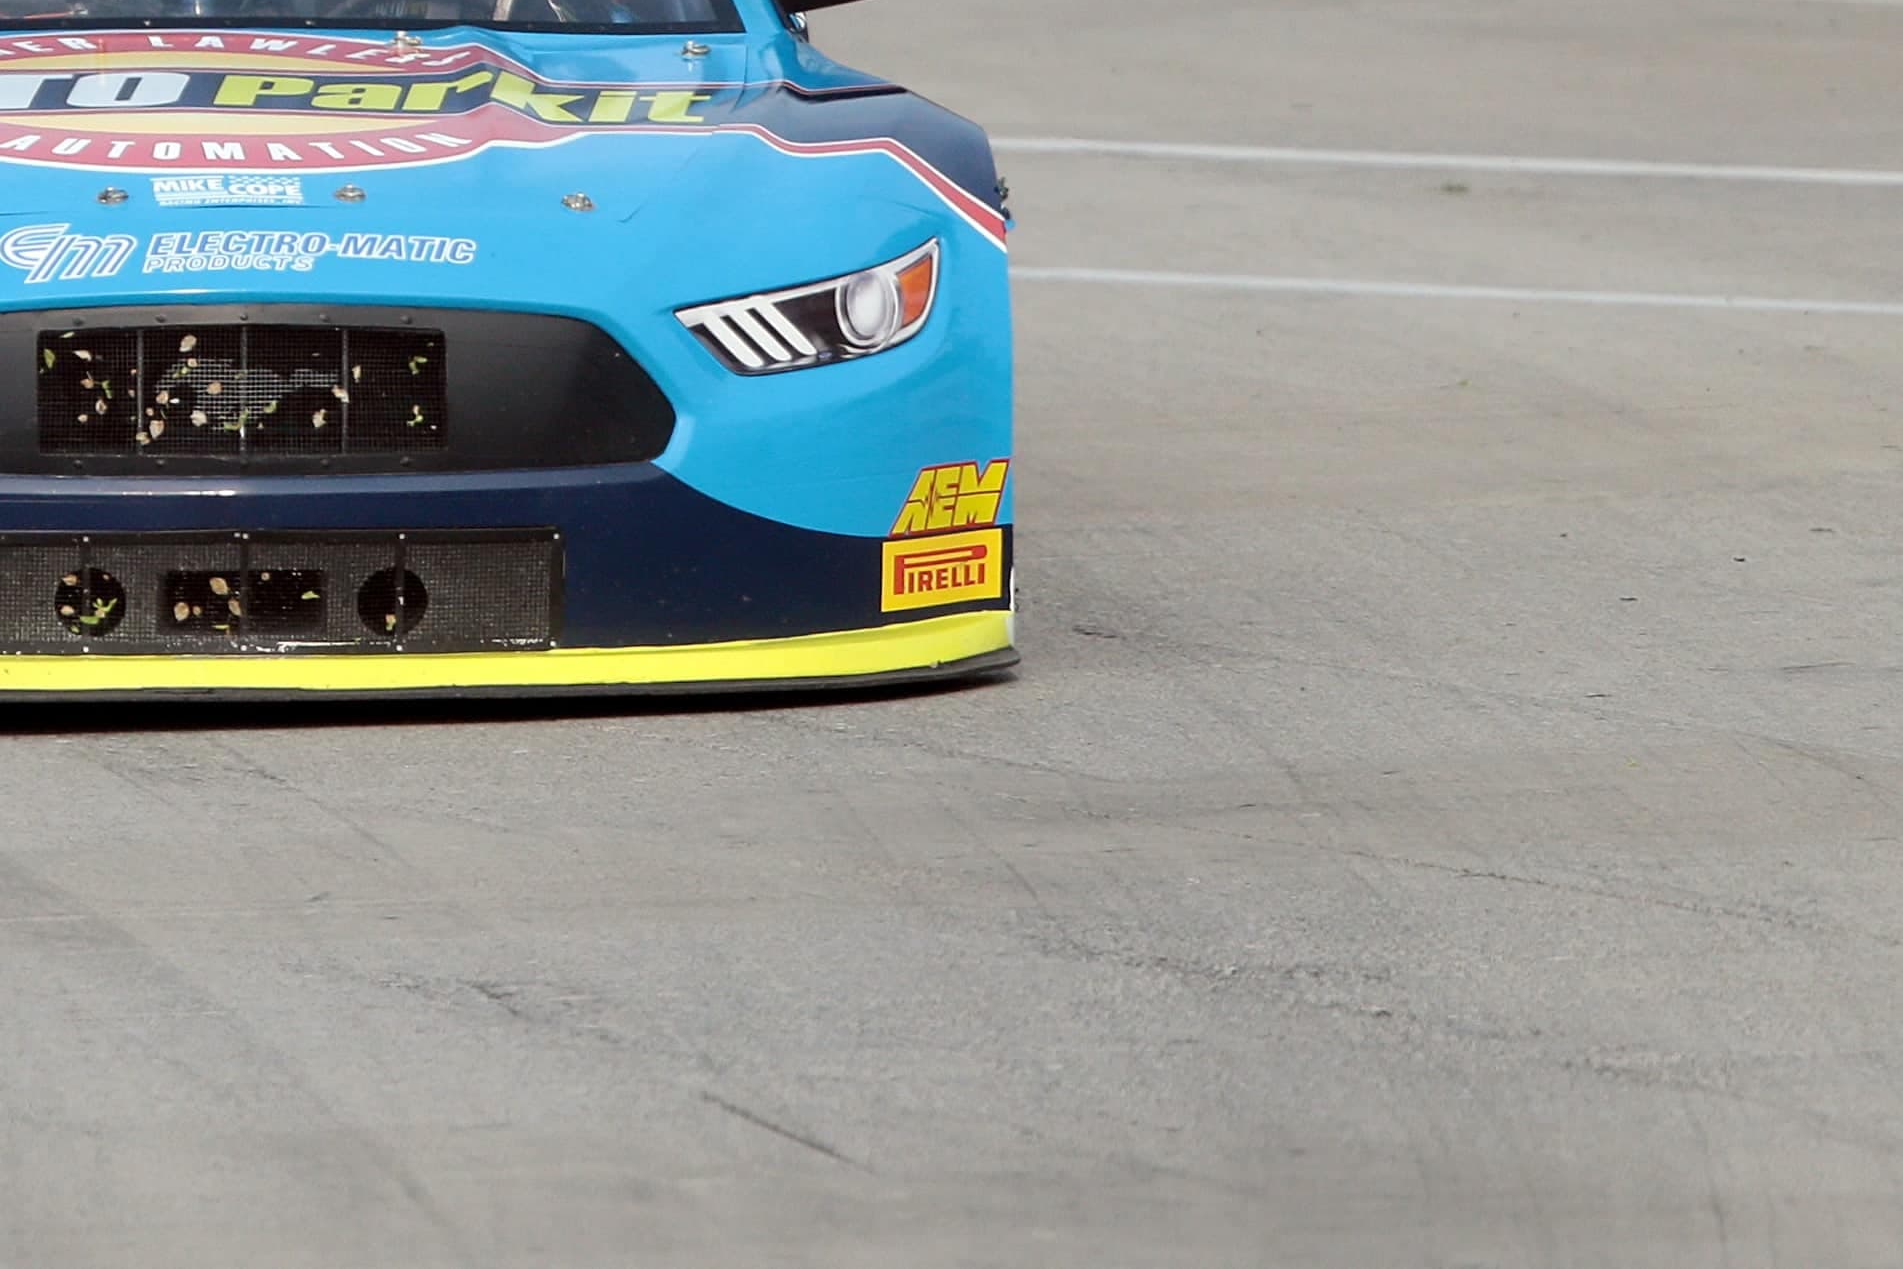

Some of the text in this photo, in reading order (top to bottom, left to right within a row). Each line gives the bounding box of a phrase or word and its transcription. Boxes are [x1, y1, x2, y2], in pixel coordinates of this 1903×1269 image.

[153, 177, 303, 196] MIKE COPE
[142, 255, 315, 274] PRODUCTS
[149, 230, 477, 266] ELECTRO-MATIC
[890, 458, 1011, 537] AEM
[893, 544, 988, 595] PIRELLI
